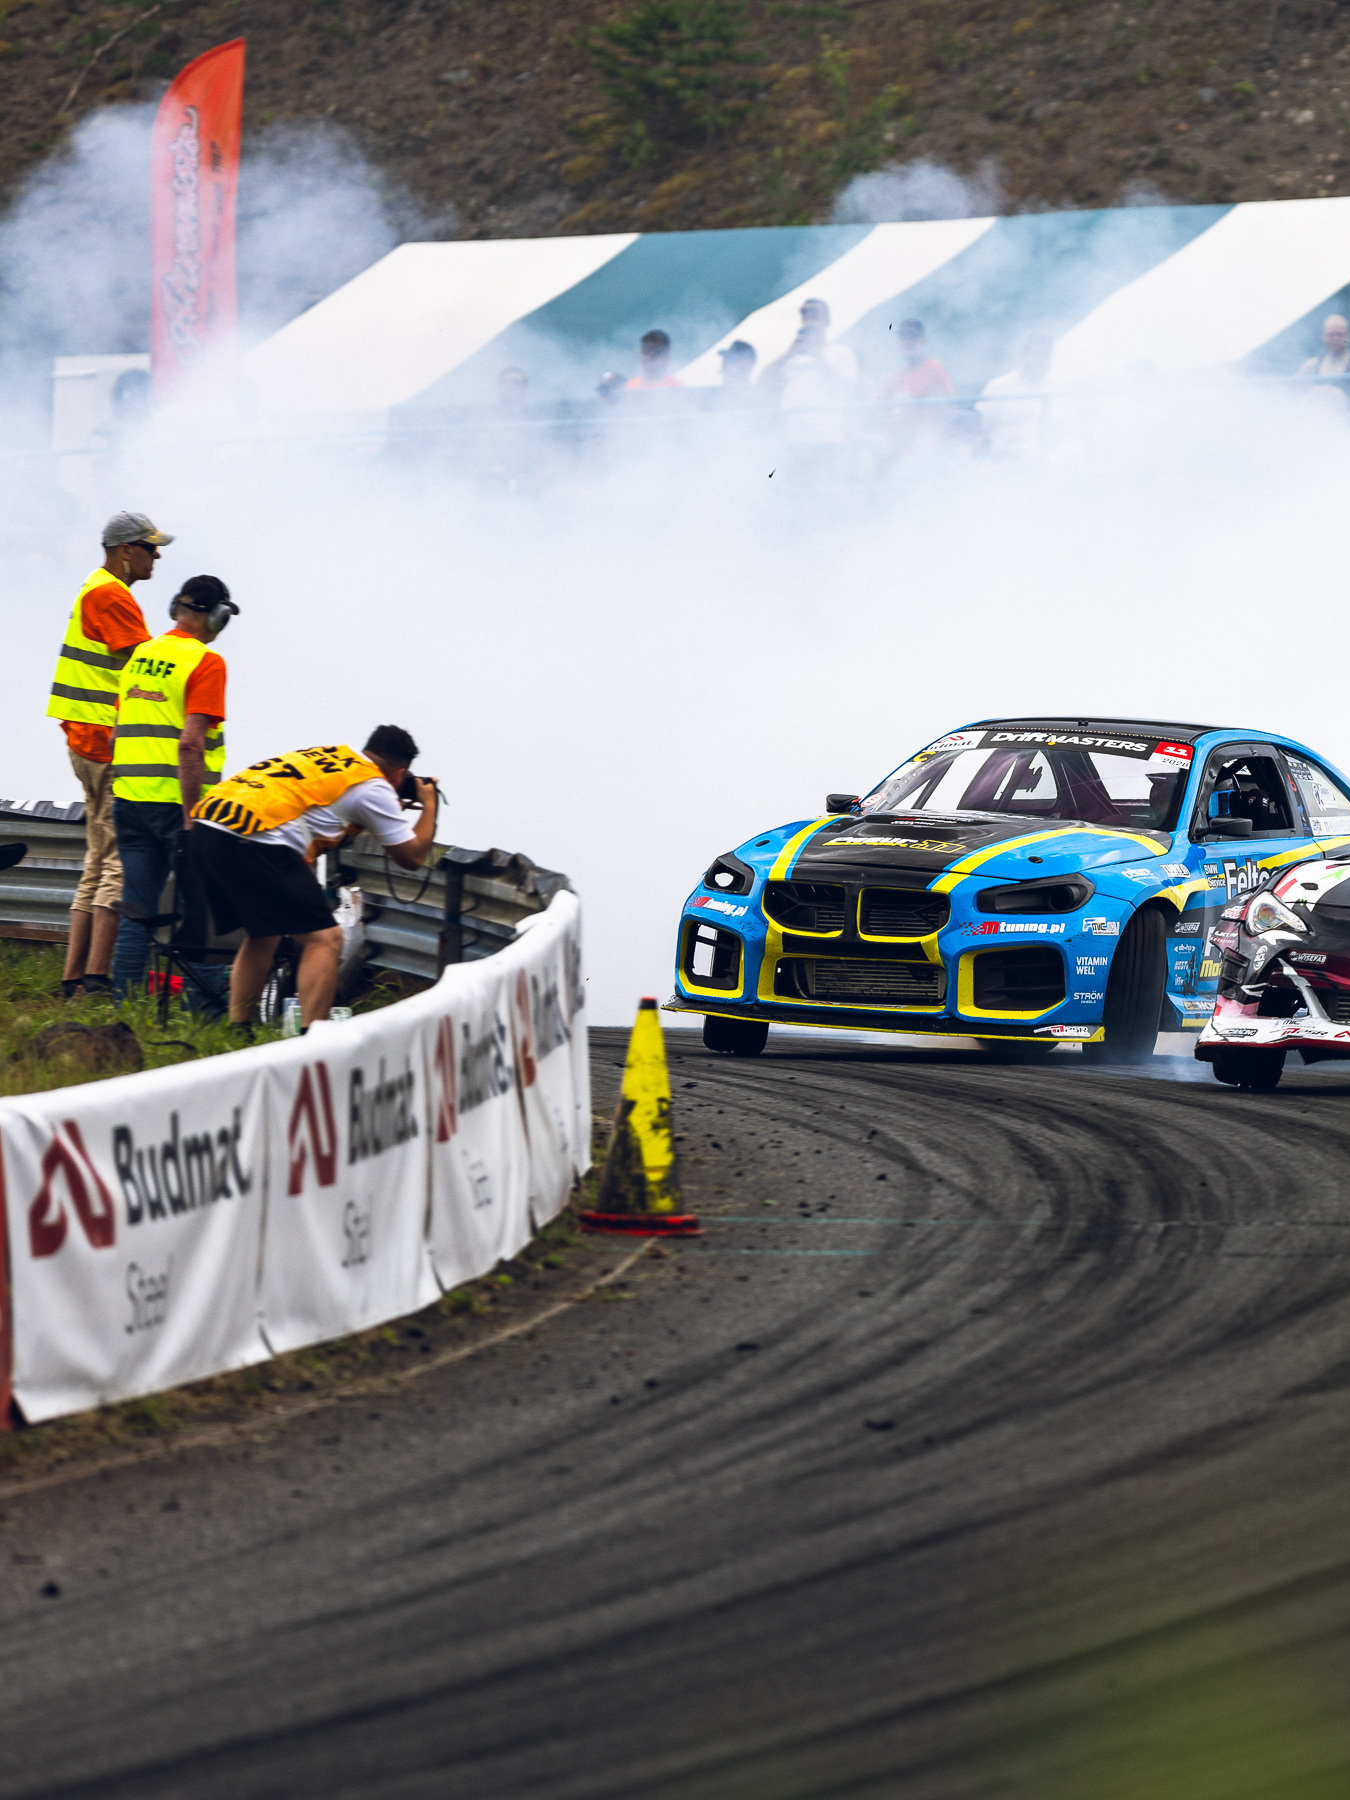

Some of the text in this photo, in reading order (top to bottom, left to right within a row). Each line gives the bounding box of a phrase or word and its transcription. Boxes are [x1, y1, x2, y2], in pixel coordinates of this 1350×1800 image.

[1208, 876, 1226, 888] Service
[1076, 956, 1108, 966] VITAMIN
[1076, 965, 1096, 975] WELL
[1073, 990, 1104, 1000] STRÖM
